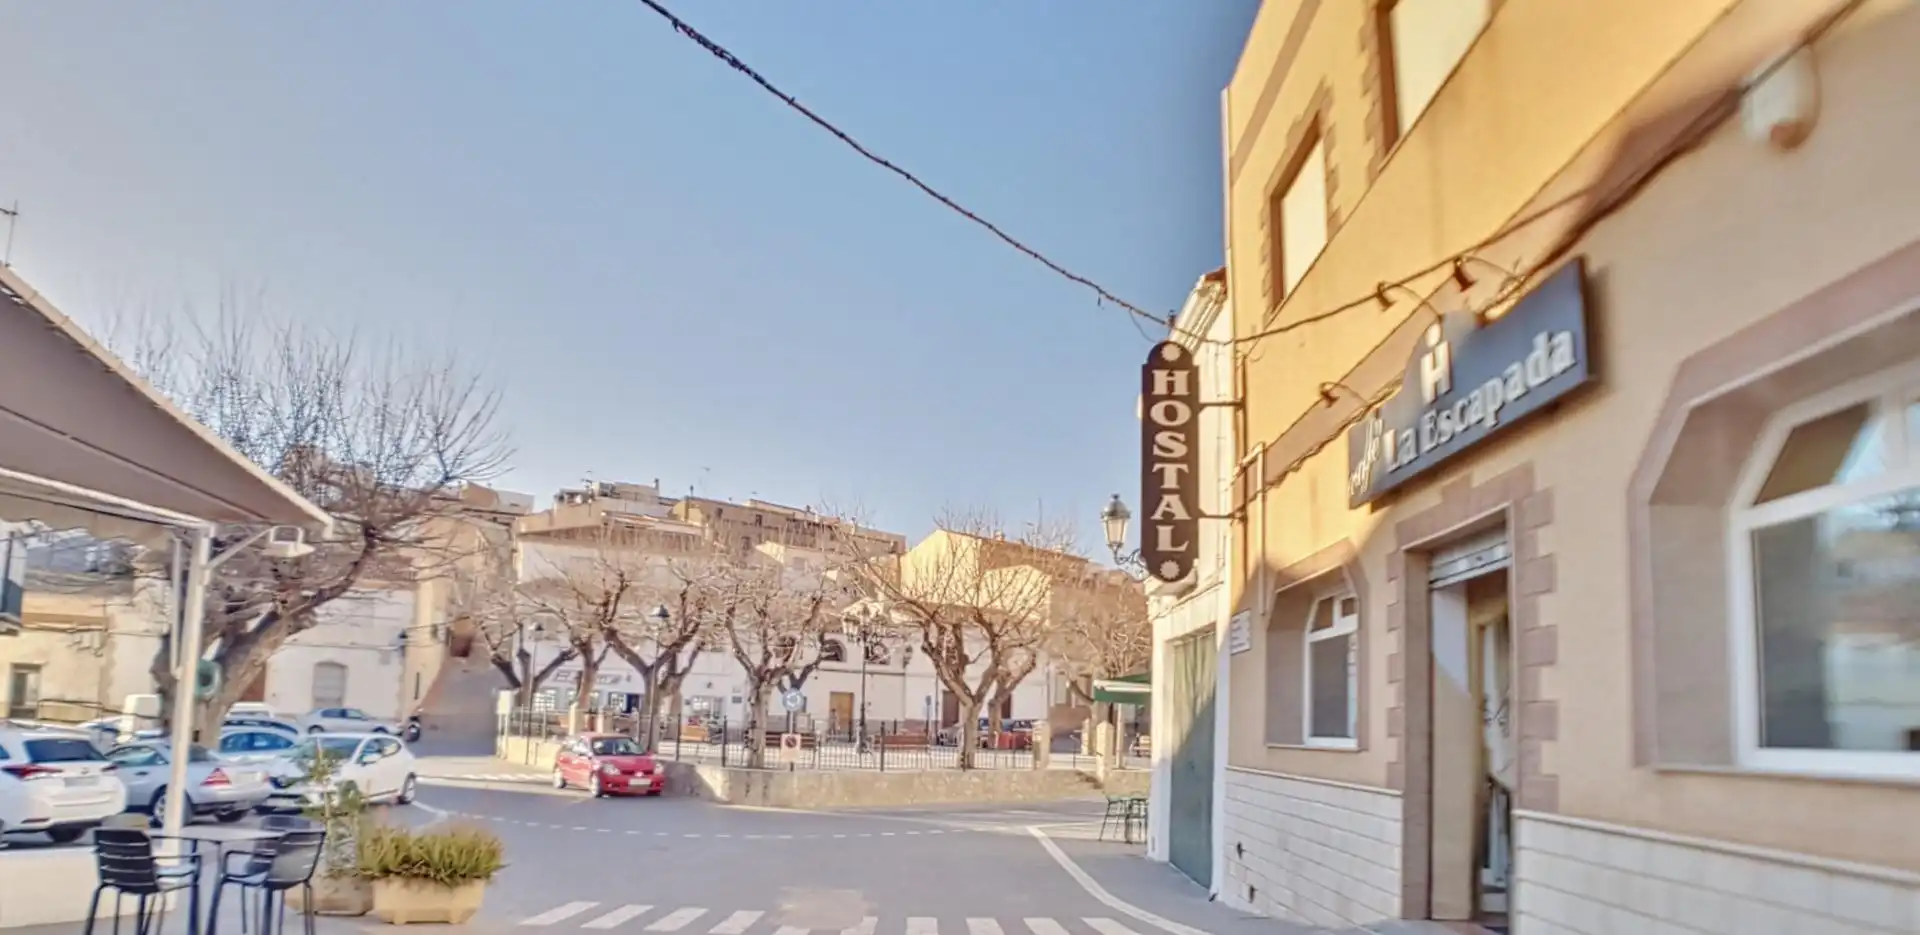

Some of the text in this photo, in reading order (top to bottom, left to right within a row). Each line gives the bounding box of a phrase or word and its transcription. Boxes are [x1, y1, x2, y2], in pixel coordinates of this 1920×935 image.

[1150, 369, 1191, 551] HOSTAL
[1383, 428, 1418, 471] La
[1420, 330, 1576, 453] Escapada
